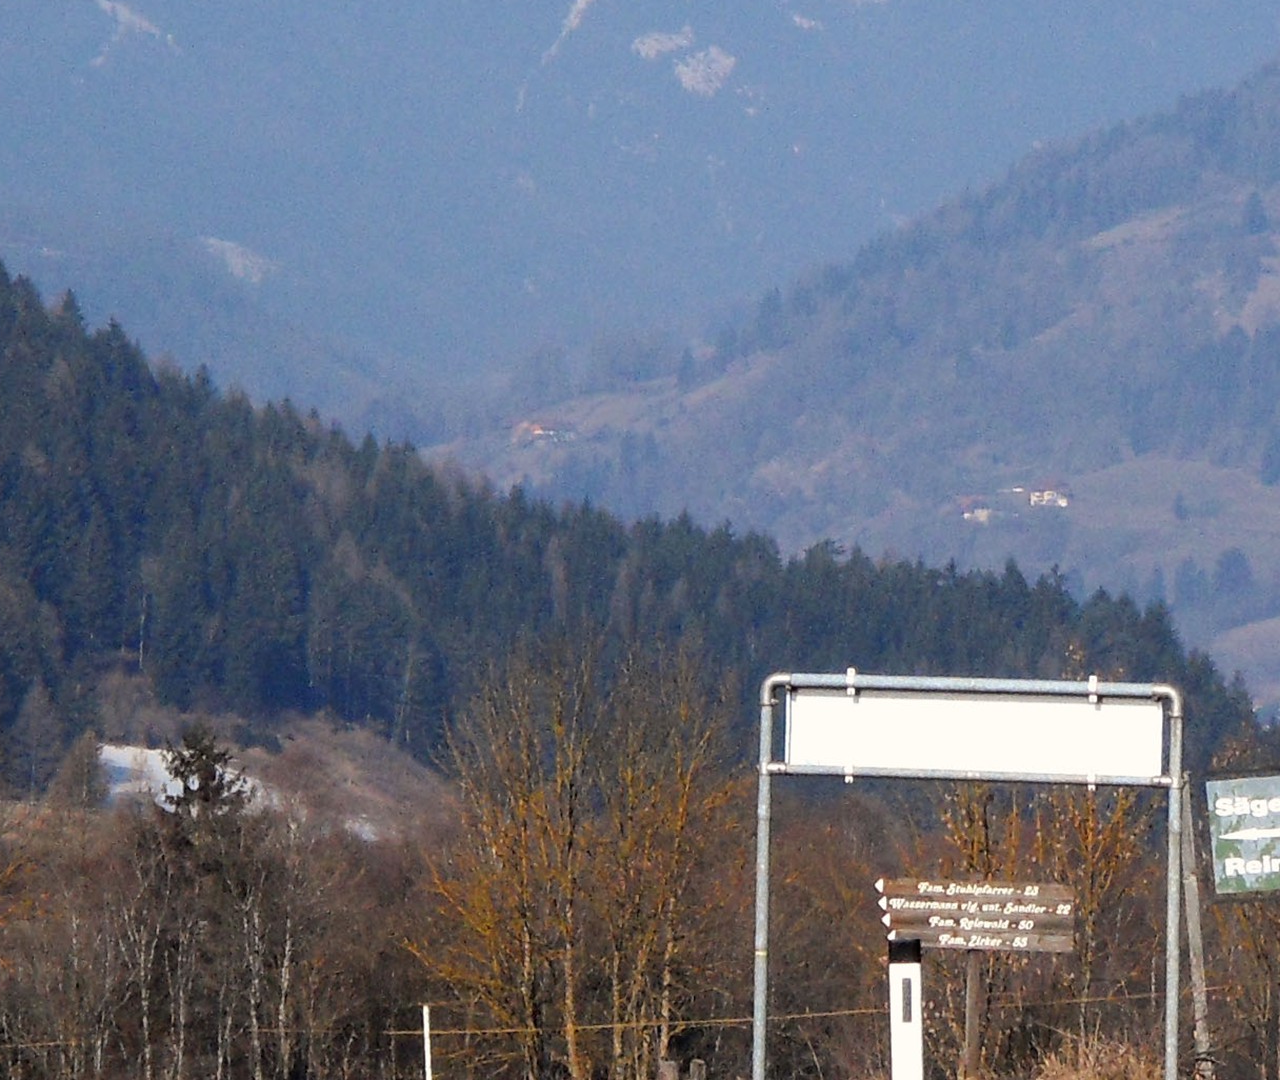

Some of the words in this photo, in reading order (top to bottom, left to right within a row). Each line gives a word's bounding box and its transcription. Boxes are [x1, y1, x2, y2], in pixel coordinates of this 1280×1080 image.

[917, 881, 945, 894] Fam.
[928, 916, 957, 928] Fam.
[938, 933, 967, 946] Fam.
